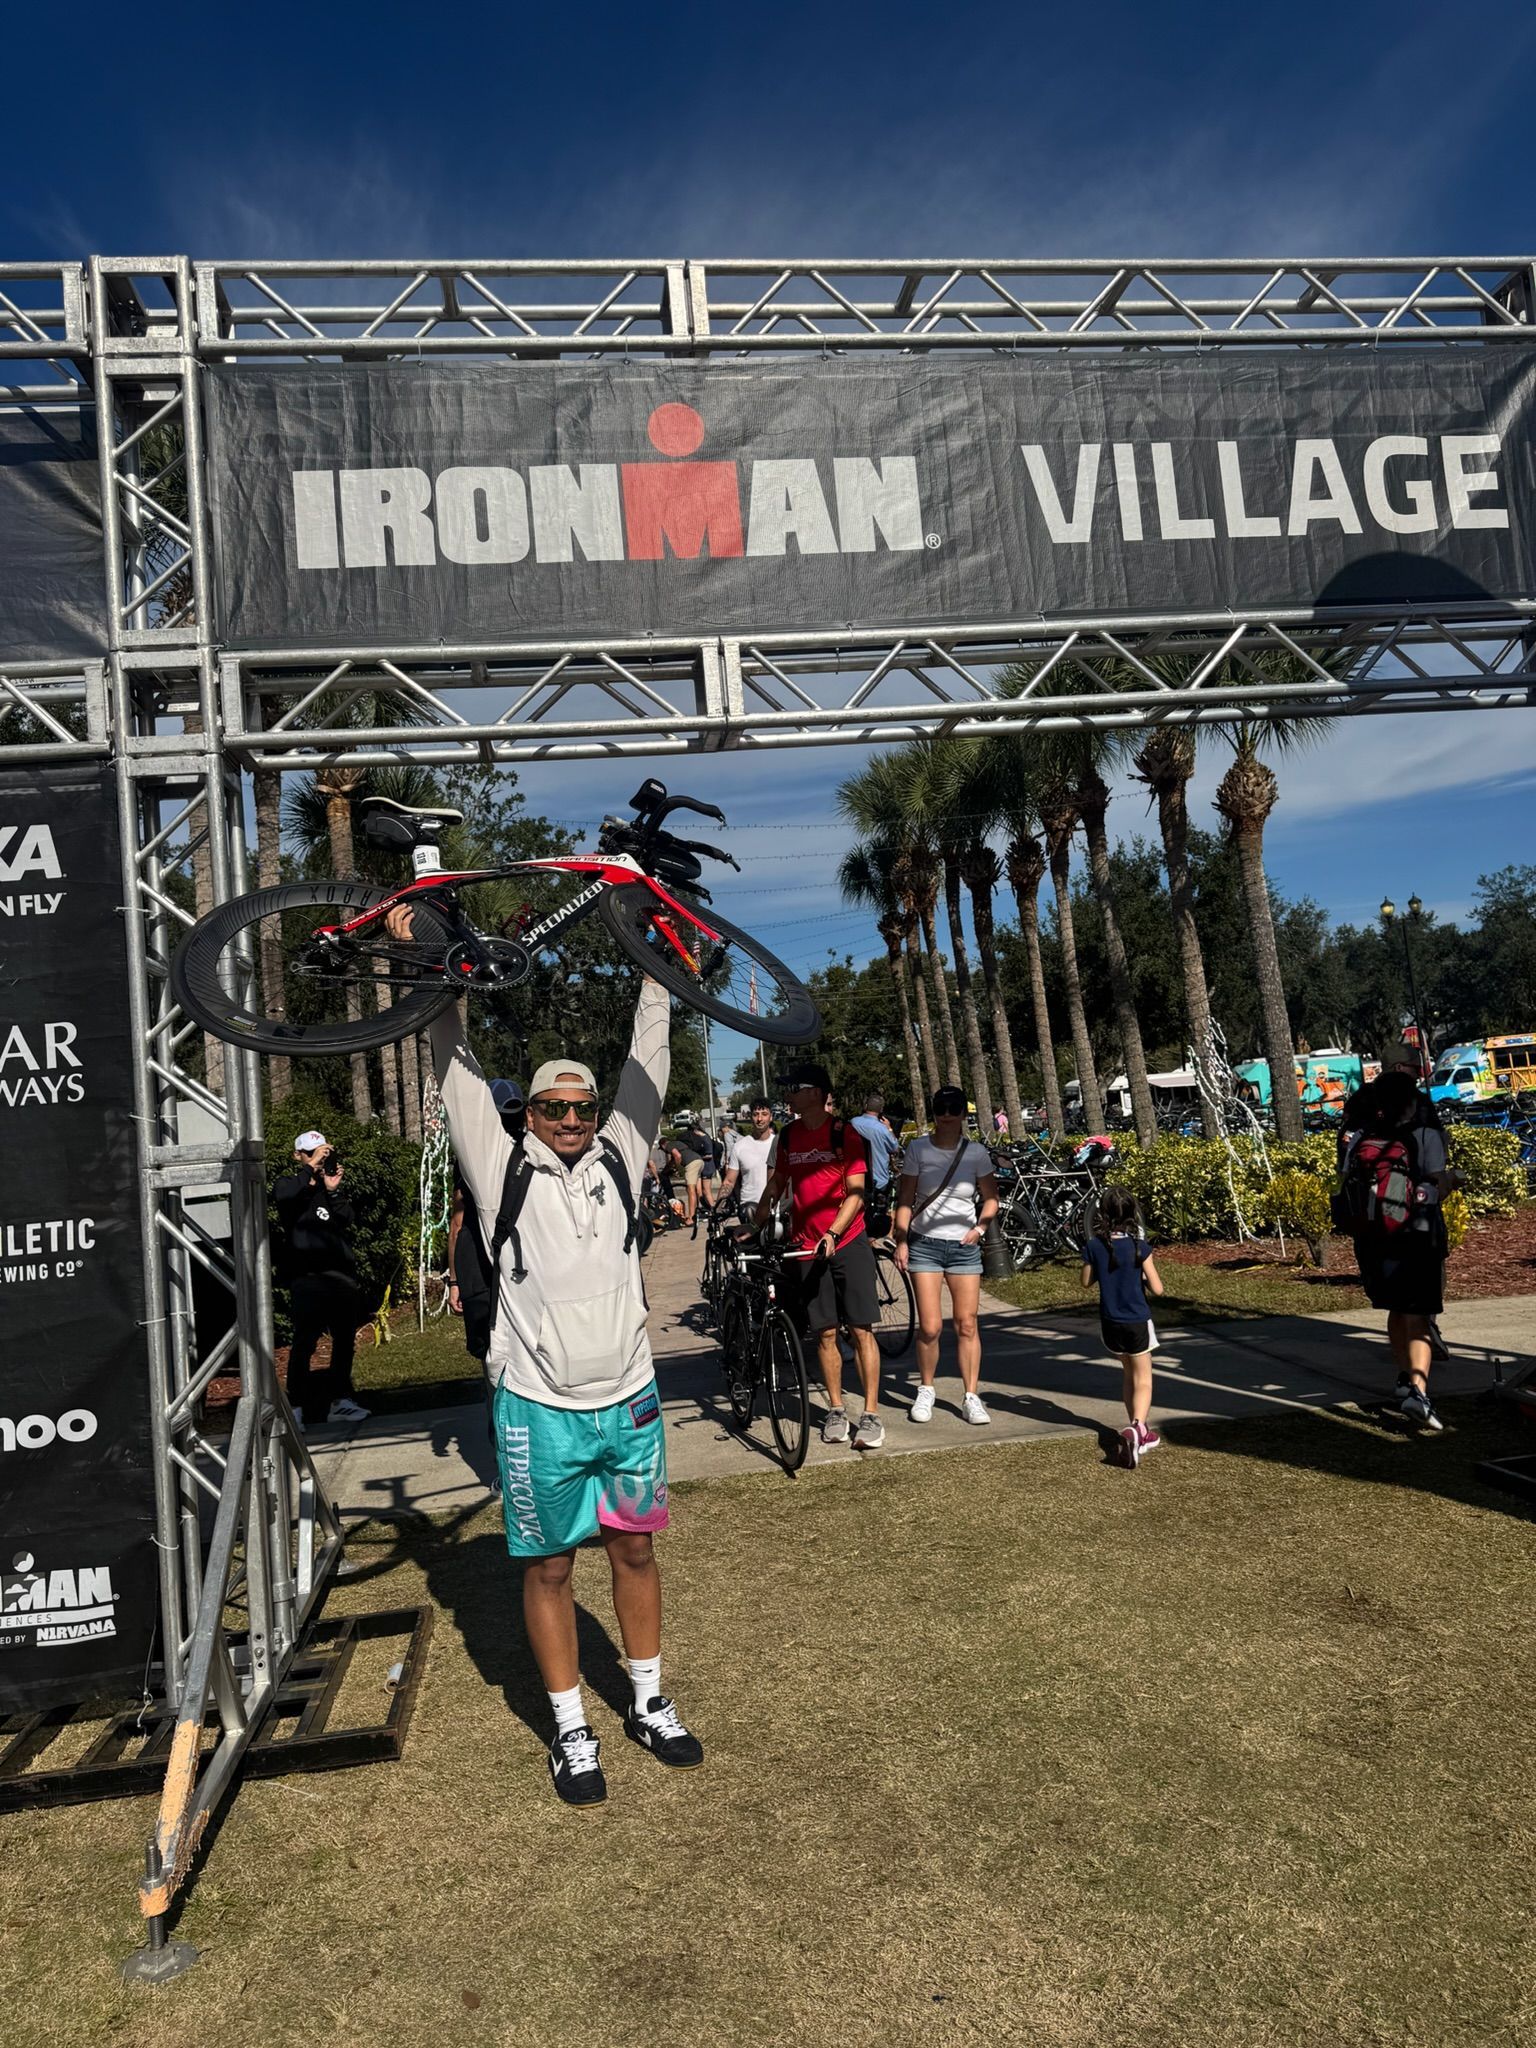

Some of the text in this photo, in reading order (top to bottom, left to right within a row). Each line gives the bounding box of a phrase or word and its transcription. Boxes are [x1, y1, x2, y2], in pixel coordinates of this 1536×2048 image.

[1021, 434, 1510, 543] VILLAGE
[19, 892, 63, 916] FLY
[520, 881, 604, 947] SPECIALIZED
[0, 1021, 84, 1073] AR
[0, 1217, 96, 1257] LETIC
[0, 1263, 49, 1284] WING
[505, 1425, 546, 1545] HYPECONIC
[0, 1566, 113, 1613] MAN
[14, 1634, 26, 1643] BY
[36, 1618, 117, 1642] NIRVANA
